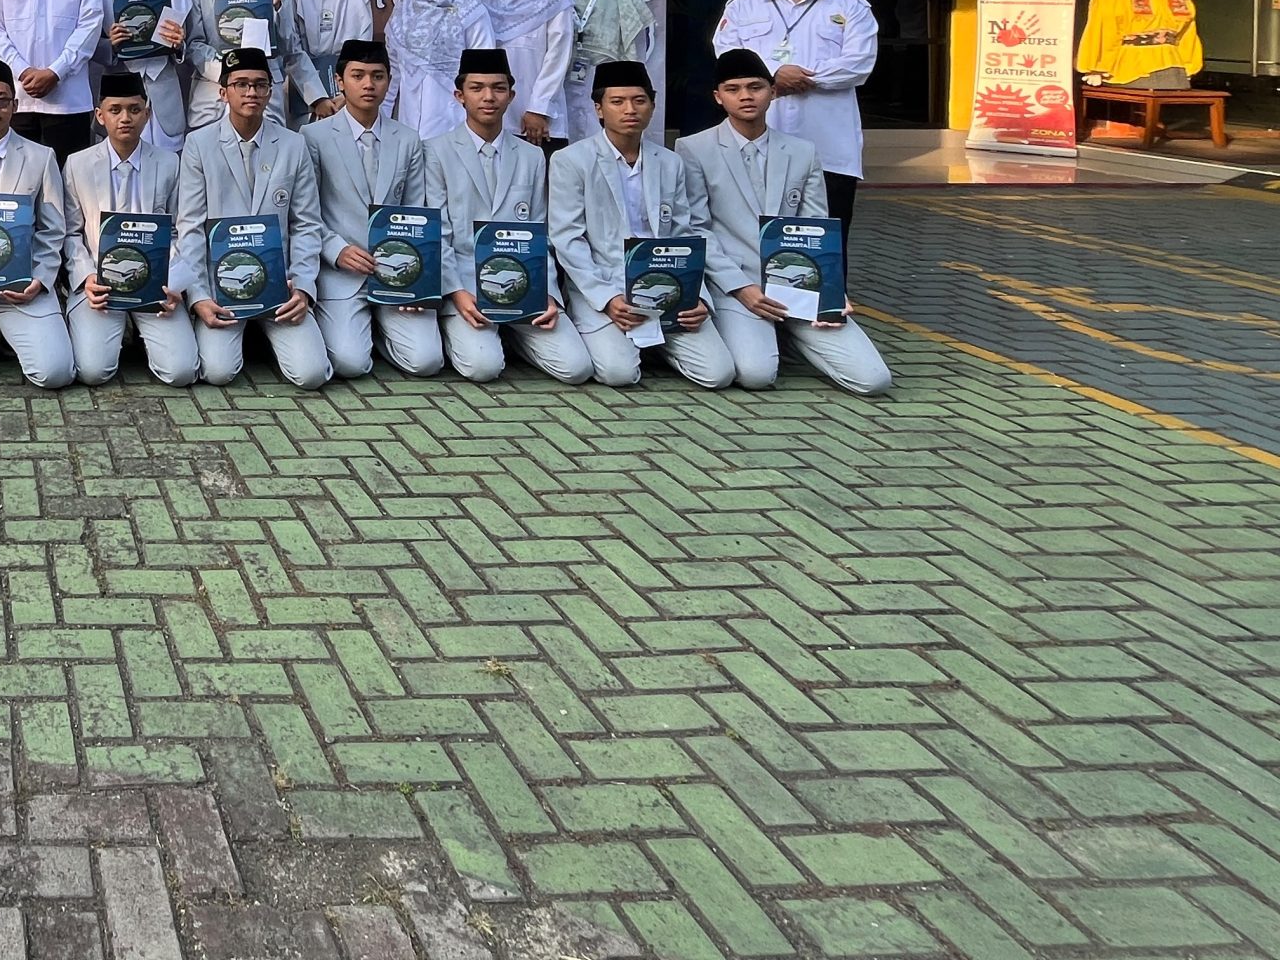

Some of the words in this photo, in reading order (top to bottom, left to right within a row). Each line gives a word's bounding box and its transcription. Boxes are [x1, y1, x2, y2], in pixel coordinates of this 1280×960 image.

[991, 36, 1058, 46] KRUPSI
[984, 52, 1057, 69] STP
[985, 67, 1057, 78] GRATIFIKASI
[1030, 128, 1067, 137] ZONA
